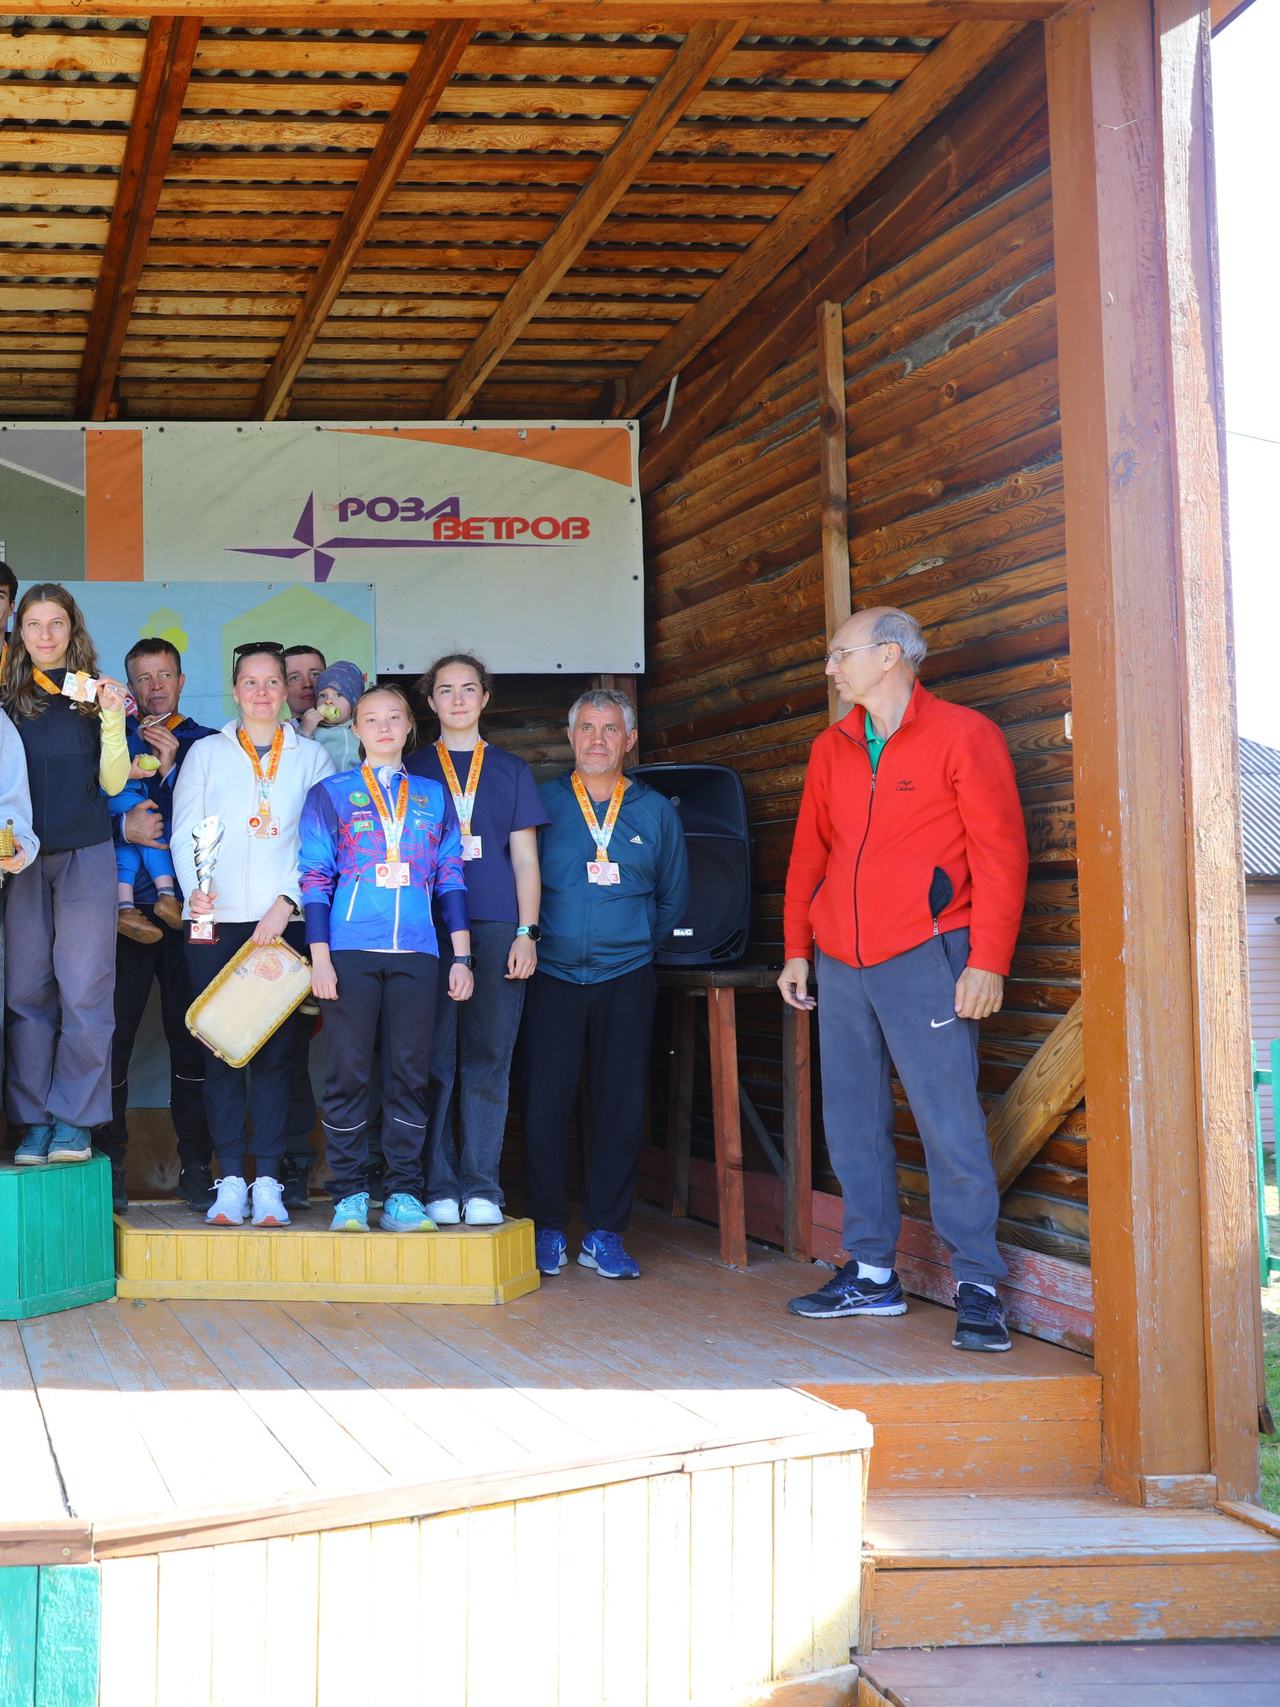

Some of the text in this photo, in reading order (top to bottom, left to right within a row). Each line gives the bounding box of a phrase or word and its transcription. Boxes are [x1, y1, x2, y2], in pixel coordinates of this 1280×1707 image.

[338, 496, 461, 522] РОЗА
[433, 516, 591, 541] ВЕТРОВ
[271, 827, 278, 836] 3
[473, 848, 481, 857] 3
[401, 875, 409, 884] 3
[612, 873, 619, 882] 3
